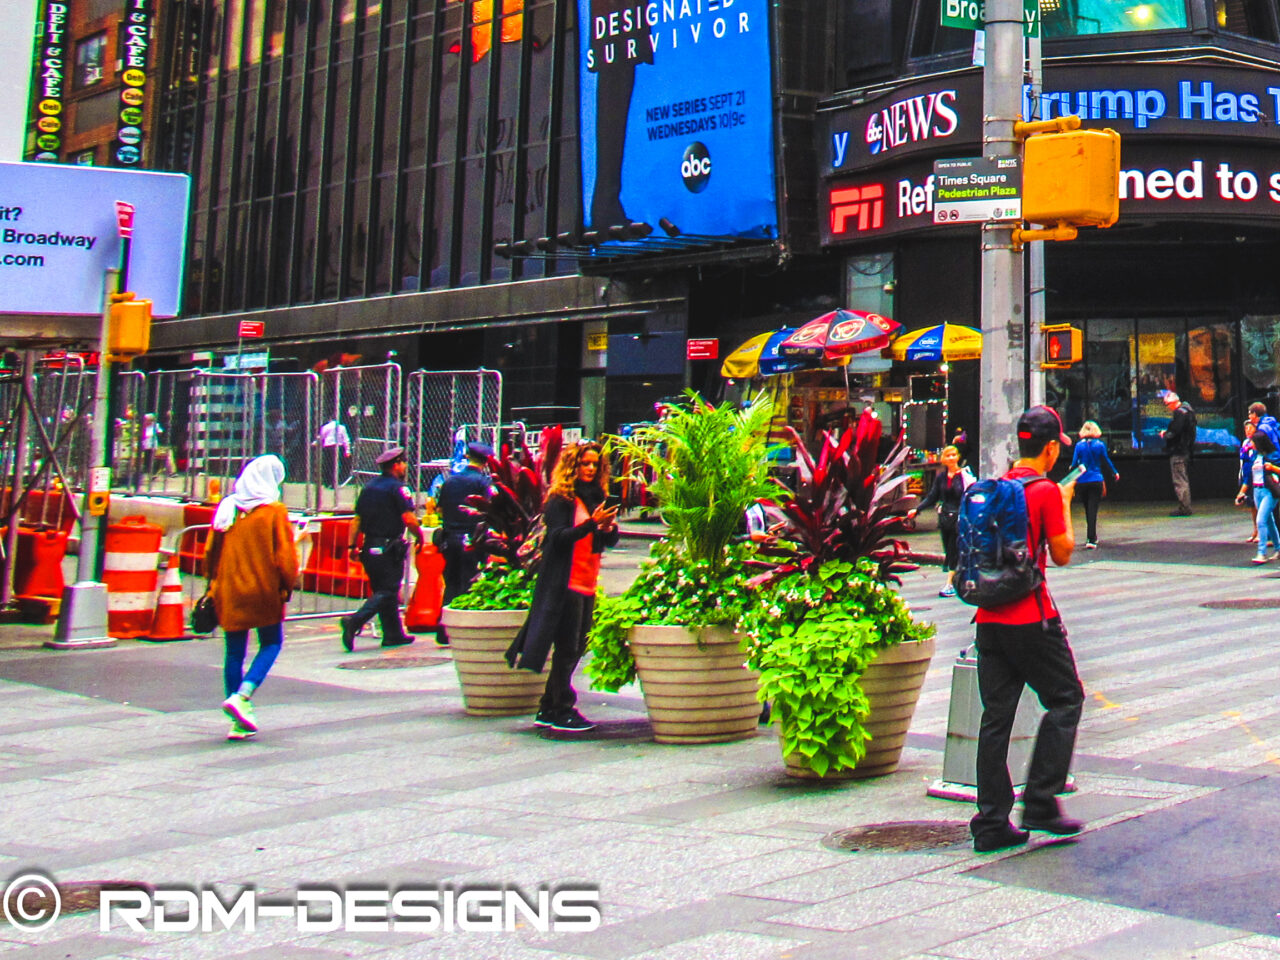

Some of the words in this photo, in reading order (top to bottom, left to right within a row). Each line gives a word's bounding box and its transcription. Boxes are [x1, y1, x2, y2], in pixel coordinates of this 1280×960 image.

[47, 3, 68, 44] DELI
[129, 12, 147, 23] &
[46, 46, 62, 57] &
[125, 25, 148, 68] CAFE
[586, 11, 750, 69] SURVIVOR
[42, 58, 63, 98] CAFE
[646, 105, 670, 124] NEW
[672, 94, 707, 118] SERIES
[708, 91, 733, 111] SEPT
[735, 90, 746, 107] 21
[881, 90, 959, 152] NEWS
[1178, 80, 1259, 123] Has
[646, 115, 717, 141] WEDNESDAYS
[680, 153, 712, 179] abc
[938, 175, 968, 186] Times
[970, 173, 1007, 186] Square
[1215, 162, 1258, 200] to
[938, 188, 989, 199] Pedestrian
[990, 185, 1017, 196] Plaza
[3, 228, 97, 251] Broadway
